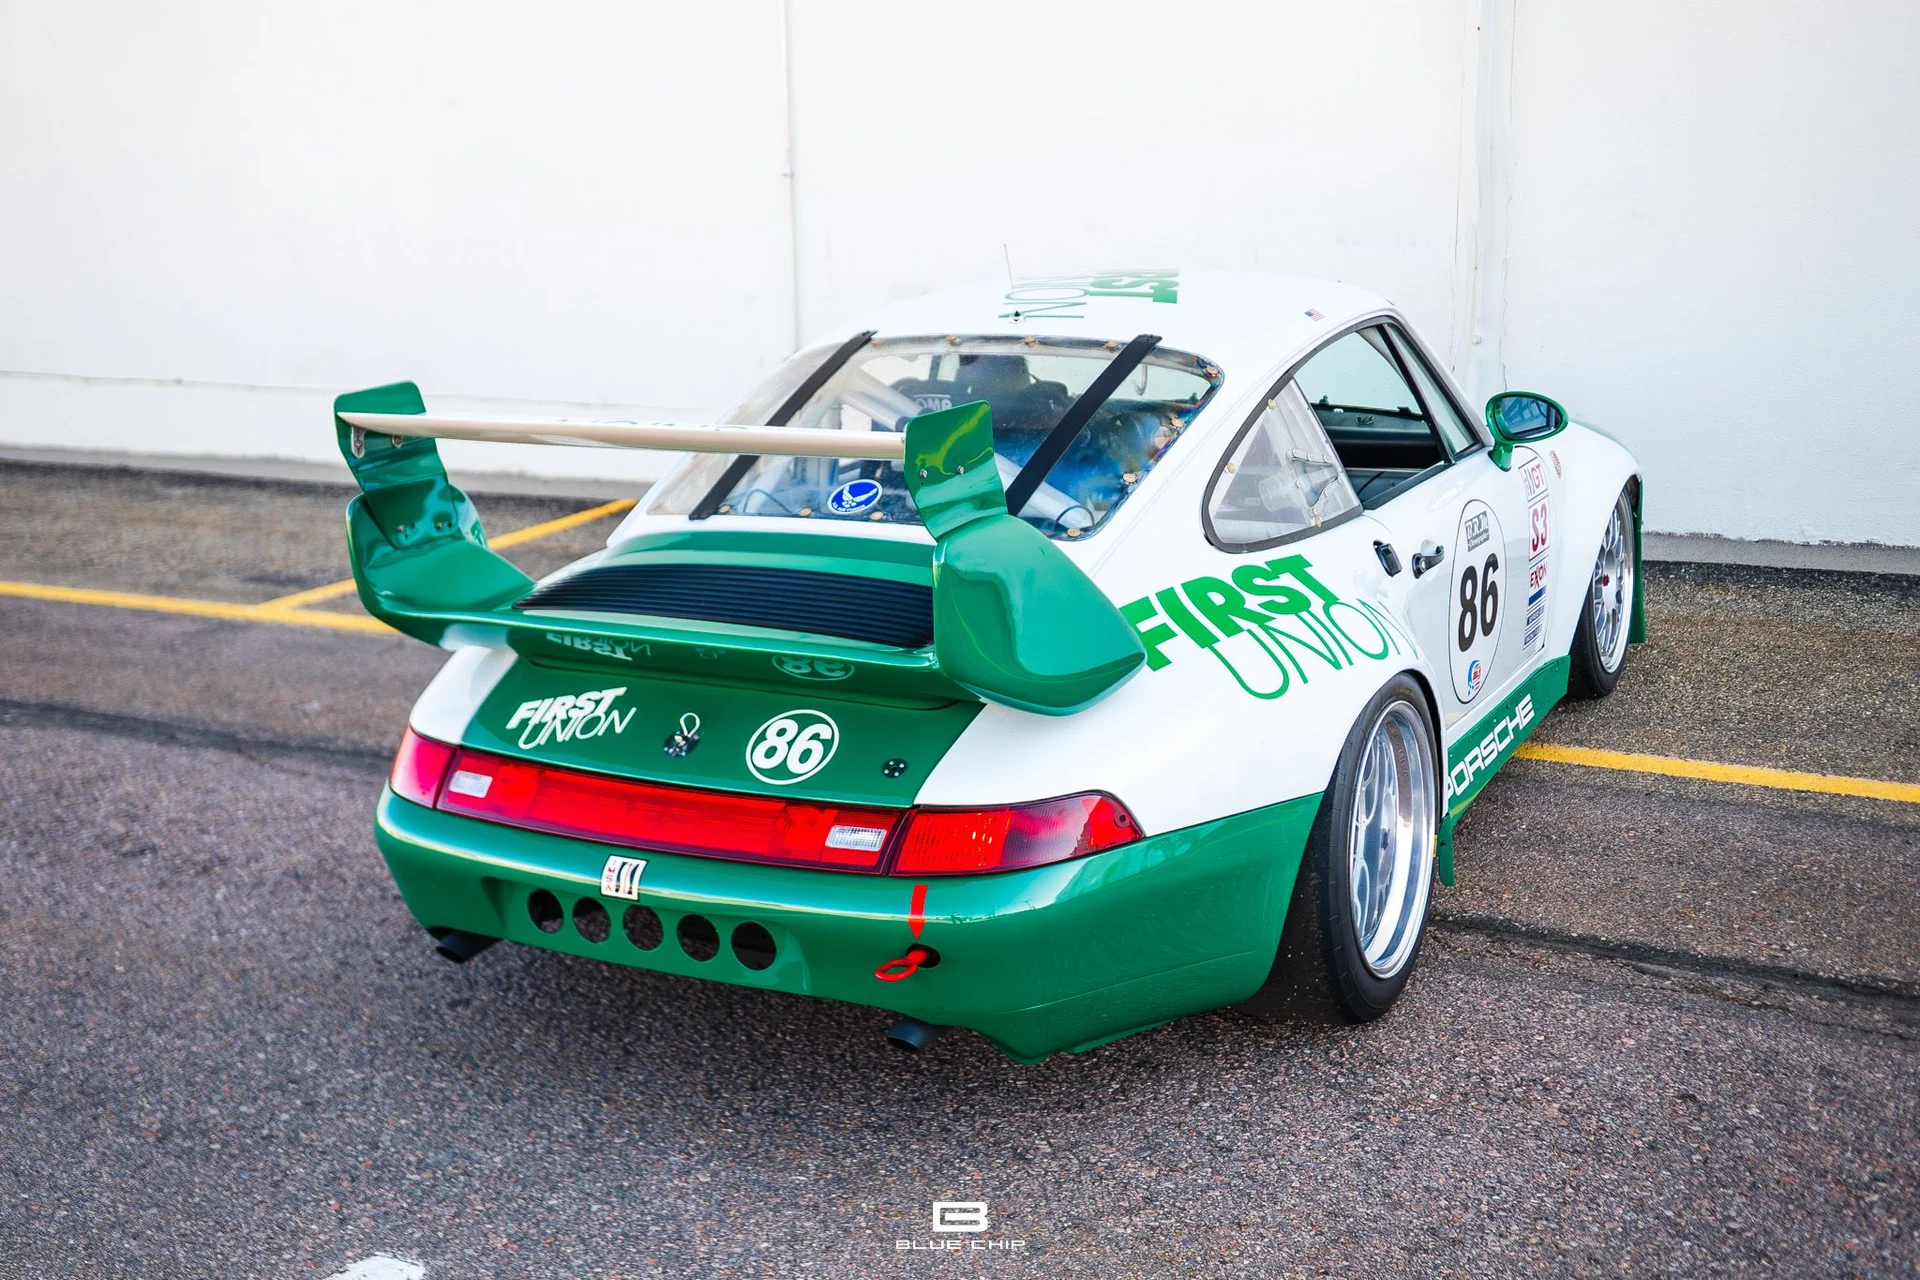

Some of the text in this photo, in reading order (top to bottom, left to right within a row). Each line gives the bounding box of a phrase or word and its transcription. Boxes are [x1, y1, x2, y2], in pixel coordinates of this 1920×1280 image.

[1532, 503, 1547, 552] S3
[1119, 554, 1340, 672] FIRST
[1458, 553, 1499, 652] 86
[1208, 598, 1419, 700] UNION
[505, 686, 628, 730] FIRST
[518, 707, 637, 750] UNION
[752, 718, 833, 774] 86
